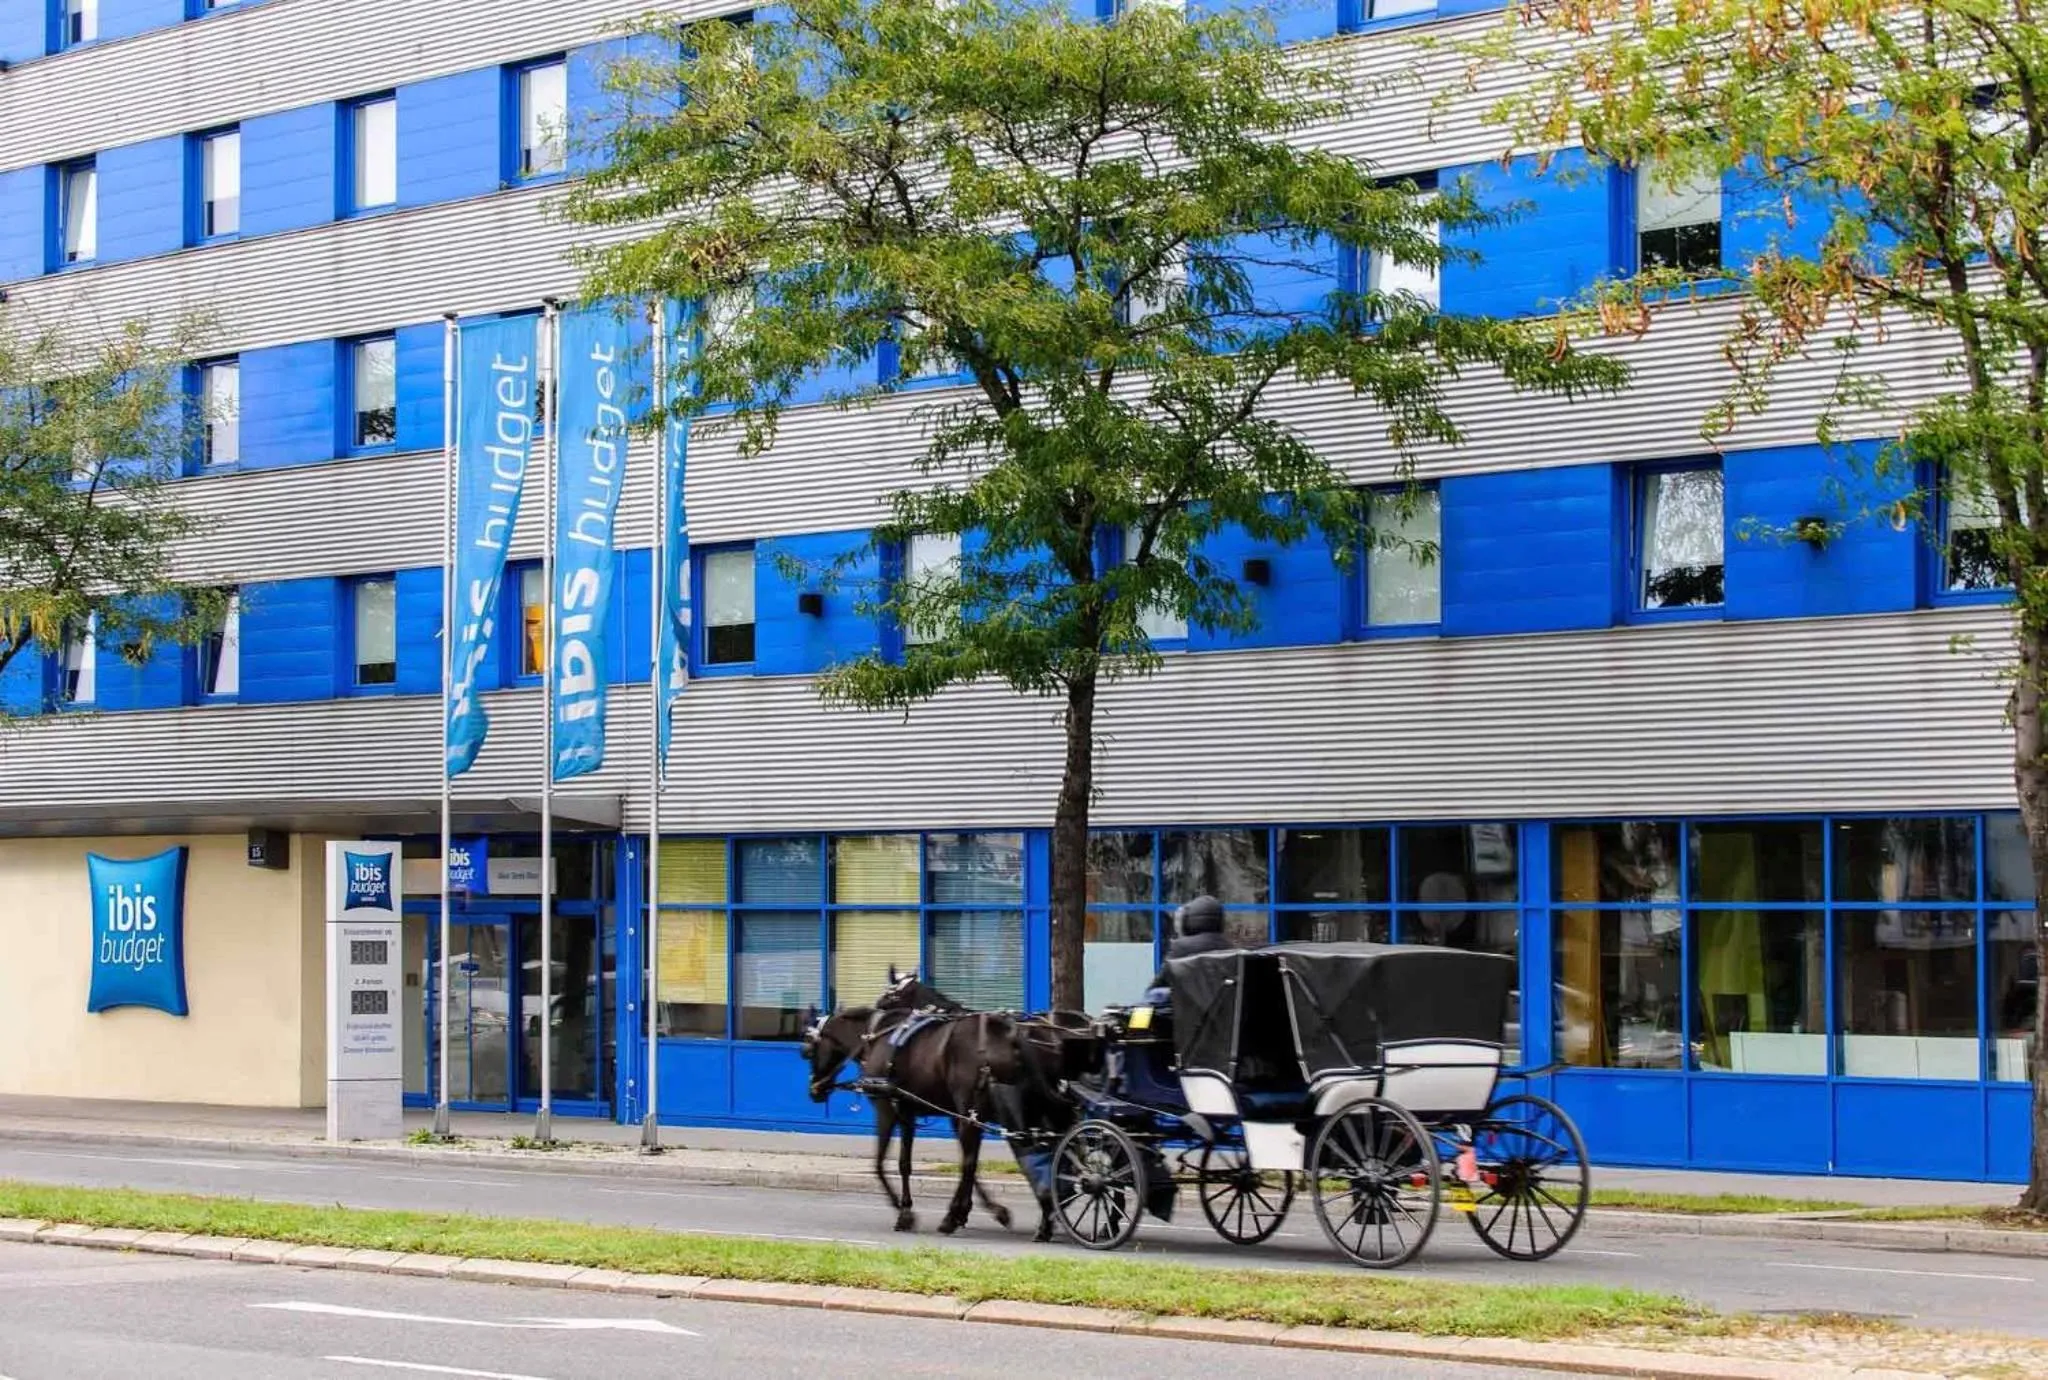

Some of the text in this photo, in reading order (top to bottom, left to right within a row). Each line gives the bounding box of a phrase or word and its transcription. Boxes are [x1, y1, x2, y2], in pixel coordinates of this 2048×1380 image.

[450, 847, 471, 866] ibis
[355, 862, 382, 881] ibis
[350, 879, 387, 896] budget
[108, 883, 157, 932] ibis
[100, 930, 165, 972] budget
